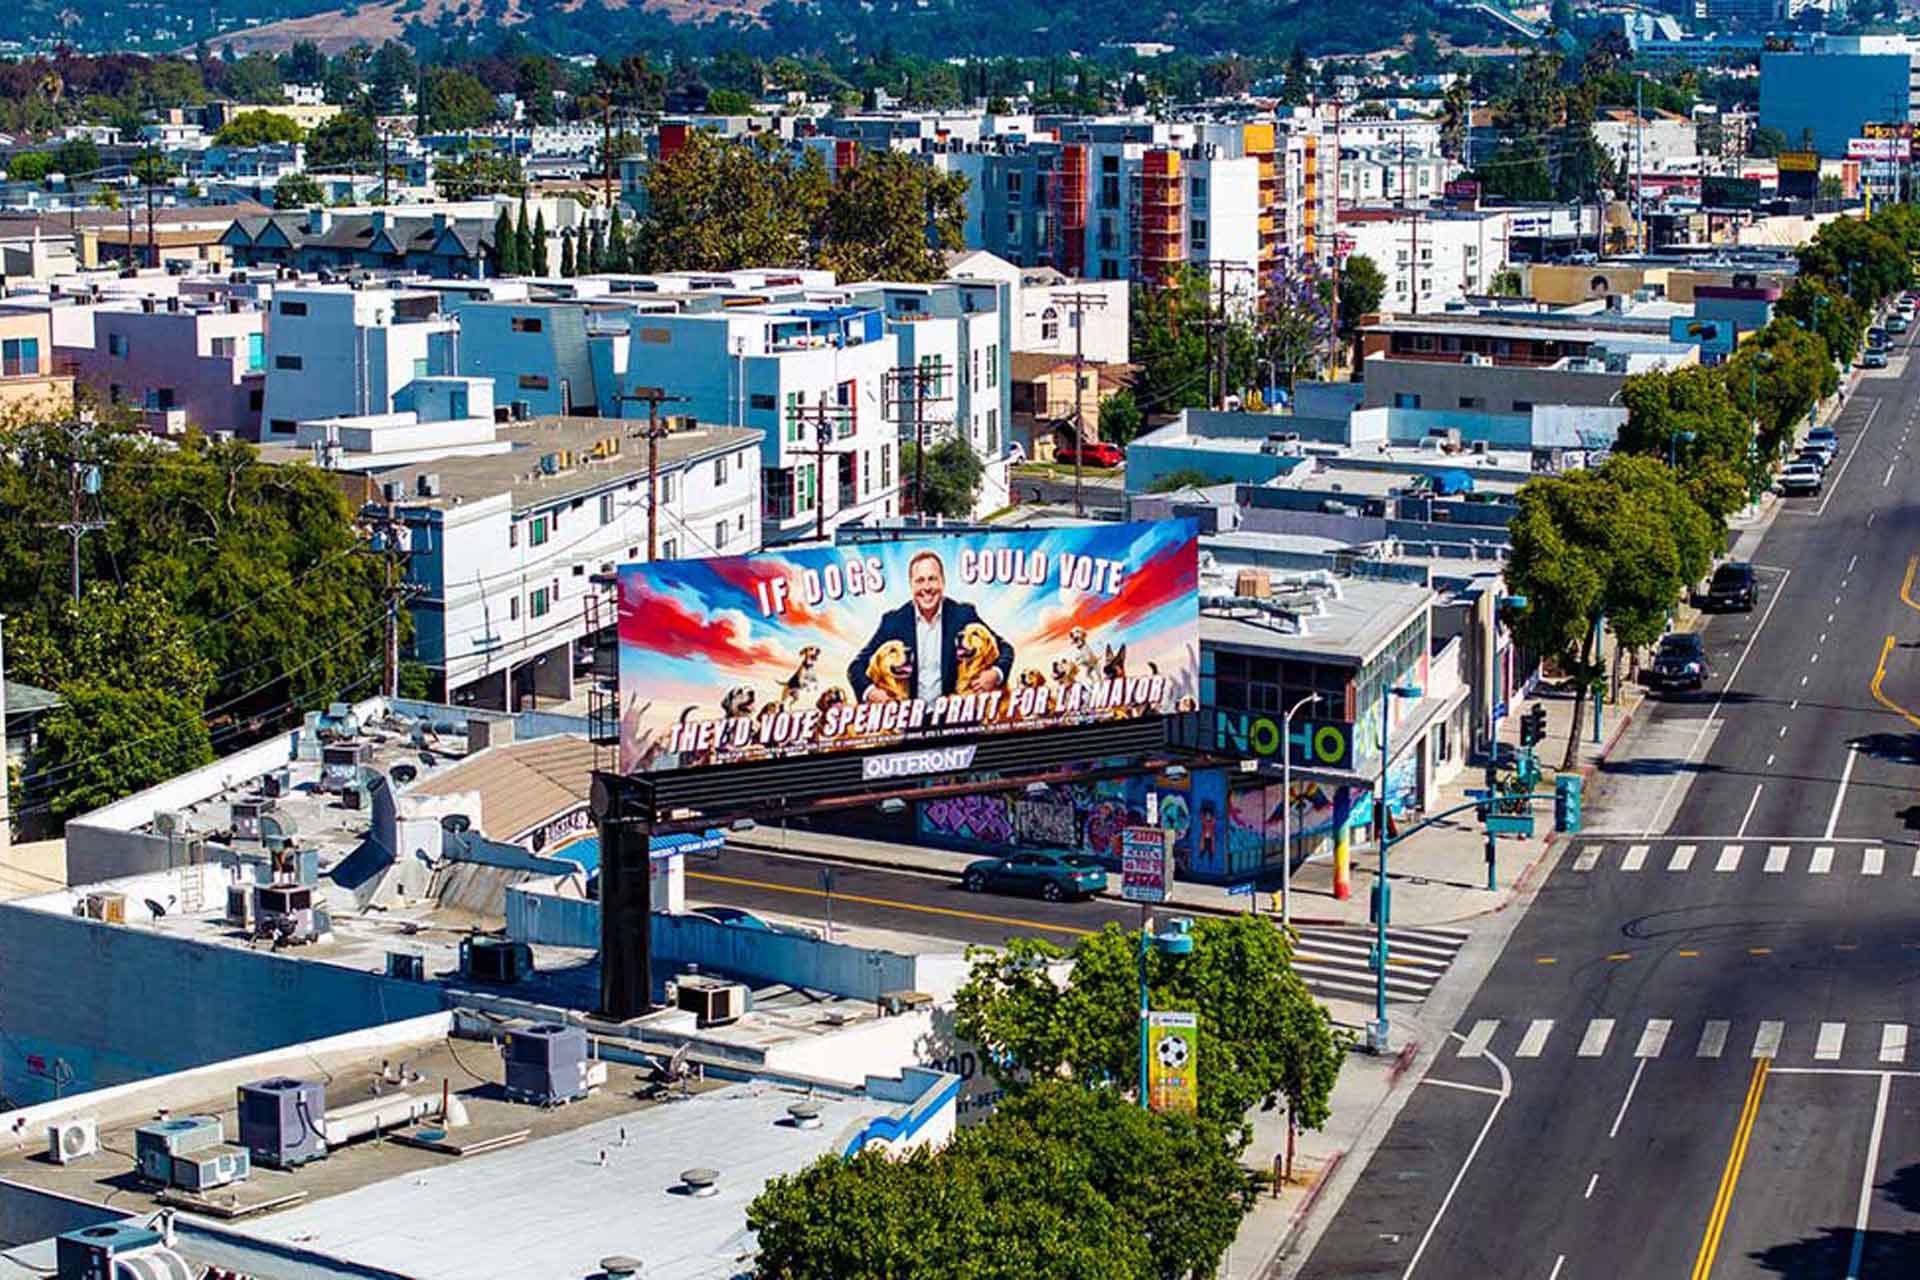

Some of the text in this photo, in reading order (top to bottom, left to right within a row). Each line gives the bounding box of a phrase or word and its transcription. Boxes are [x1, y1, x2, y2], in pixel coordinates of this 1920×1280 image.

[758, 557, 885, 617] IF DOGS
[961, 548, 1125, 596] COULD VOTE
[670, 716, 751, 753] THEY'D
[759, 709, 821, 745] VOTE
[823, 698, 926, 736] SPENCER
[931, 689, 1003, 726] PRATT
[1007, 685, 1051, 719] FOR
[1055, 681, 1083, 713] LA
[1089, 674, 1165, 709] MAYOR
[1217, 711, 1346, 764] NOHO
[866, 748, 971, 777] OUTFRONT
